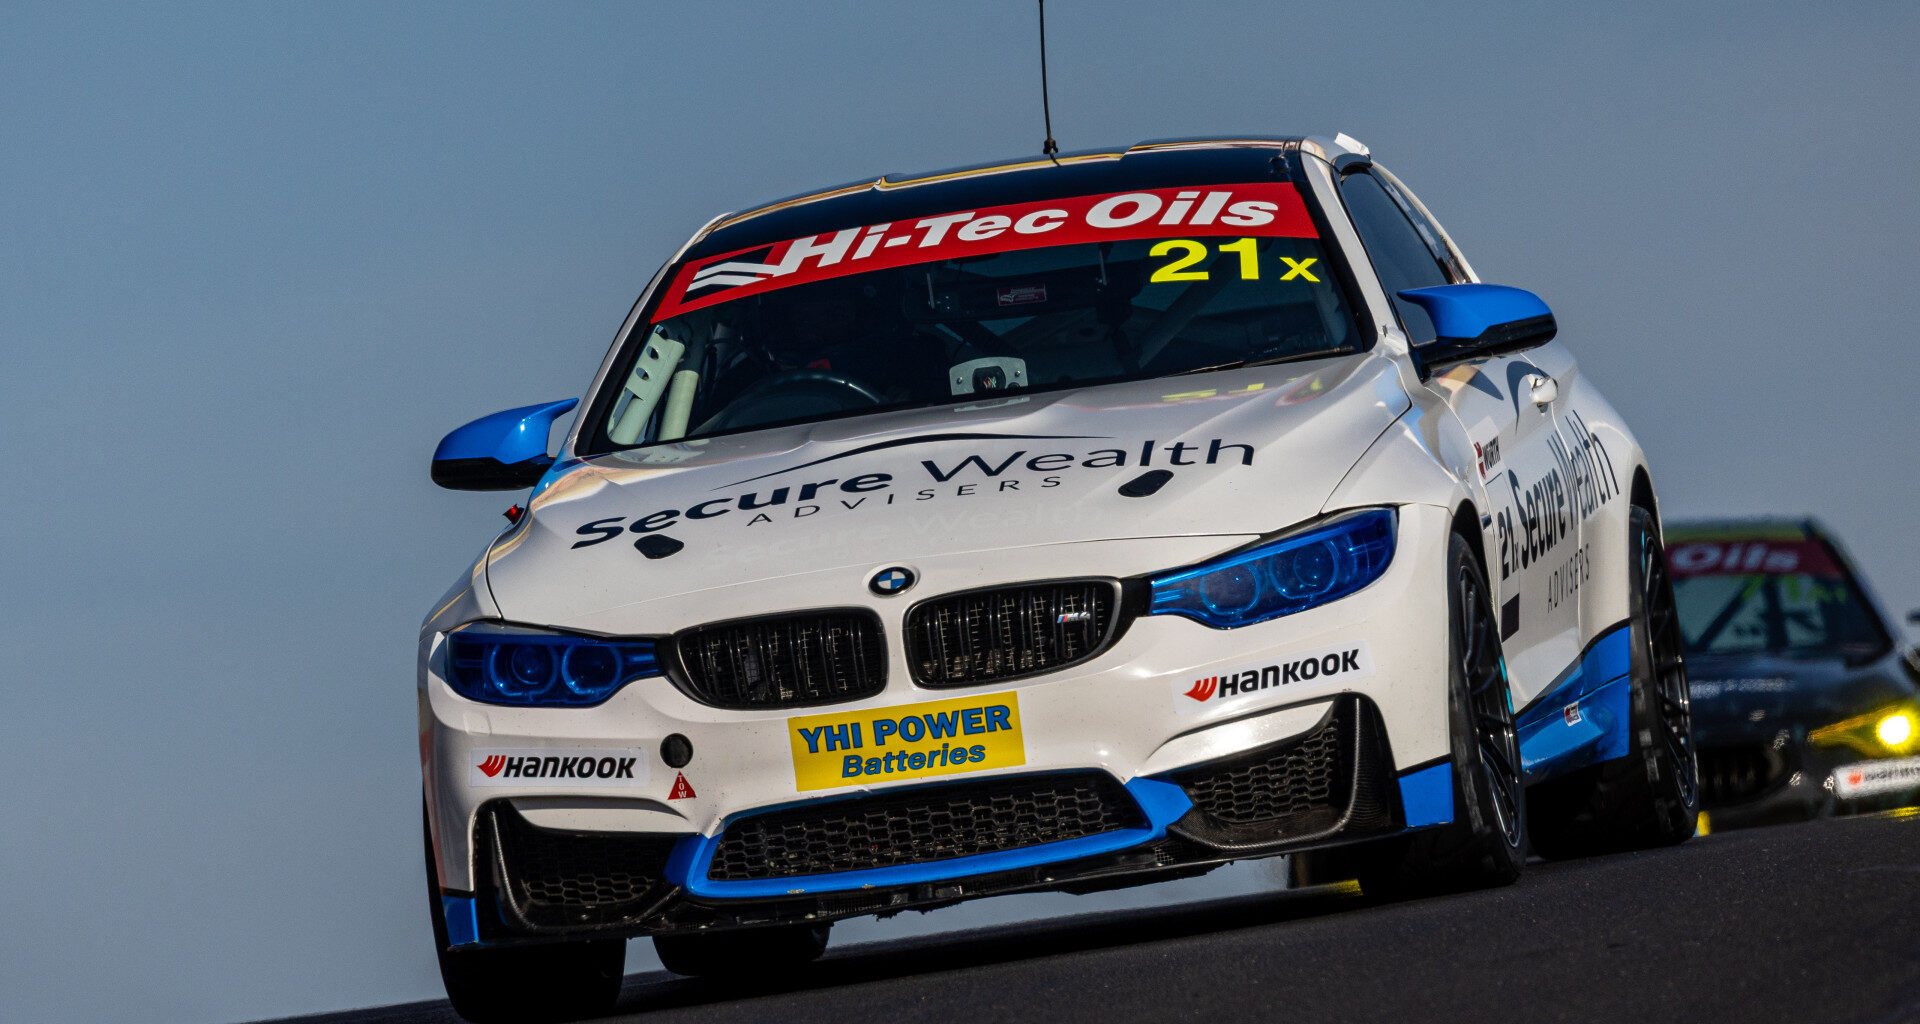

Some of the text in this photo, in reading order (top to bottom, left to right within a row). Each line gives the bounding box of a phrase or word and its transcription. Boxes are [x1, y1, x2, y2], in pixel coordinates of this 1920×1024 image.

[772, 191, 1279, 278] Hi-Tec Oils
[571, 473, 893, 550] Secure
[921, 439, 1255, 483] Wealth
[747, 476, 1061, 527] ADVISERS
[1508, 468, 1566, 570] Secure
[1546, 409, 1620, 530] Wealth
[1547, 543, 1590, 614] ADVISERS
[798, 705, 1012, 753] YHI POWER
[678, 775, 687, 798] TOW
[842, 743, 986, 778] Batteries
